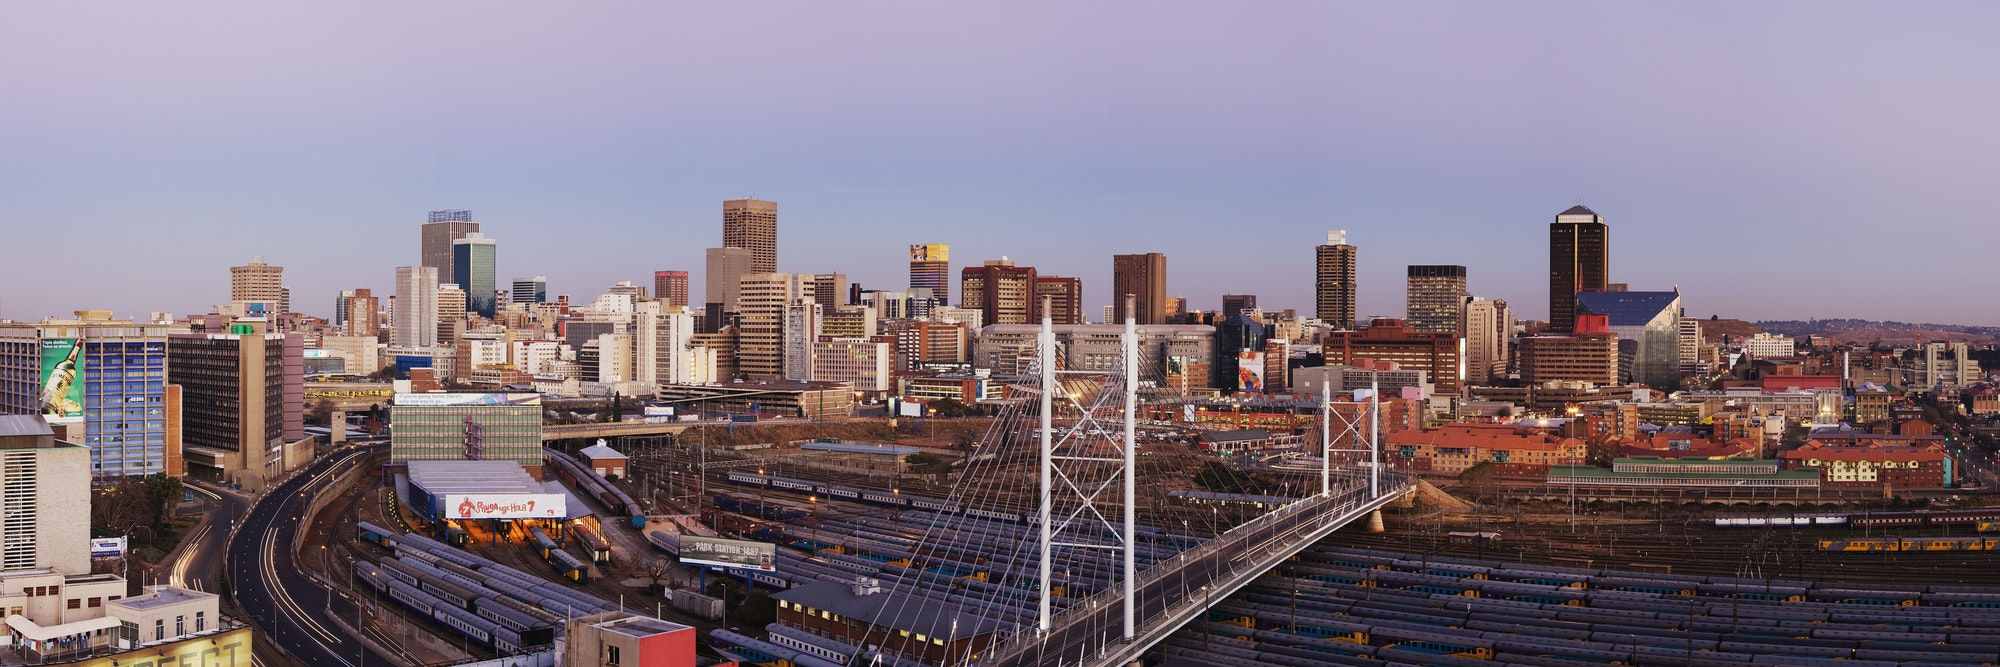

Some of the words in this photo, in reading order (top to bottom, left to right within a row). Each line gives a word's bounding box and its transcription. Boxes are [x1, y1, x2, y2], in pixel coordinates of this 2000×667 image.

[463, 506, 470, 514] 7
[527, 500, 535, 512] 7
[695, 542, 713, 551] PARK
[714, 543, 741, 554] STATION
